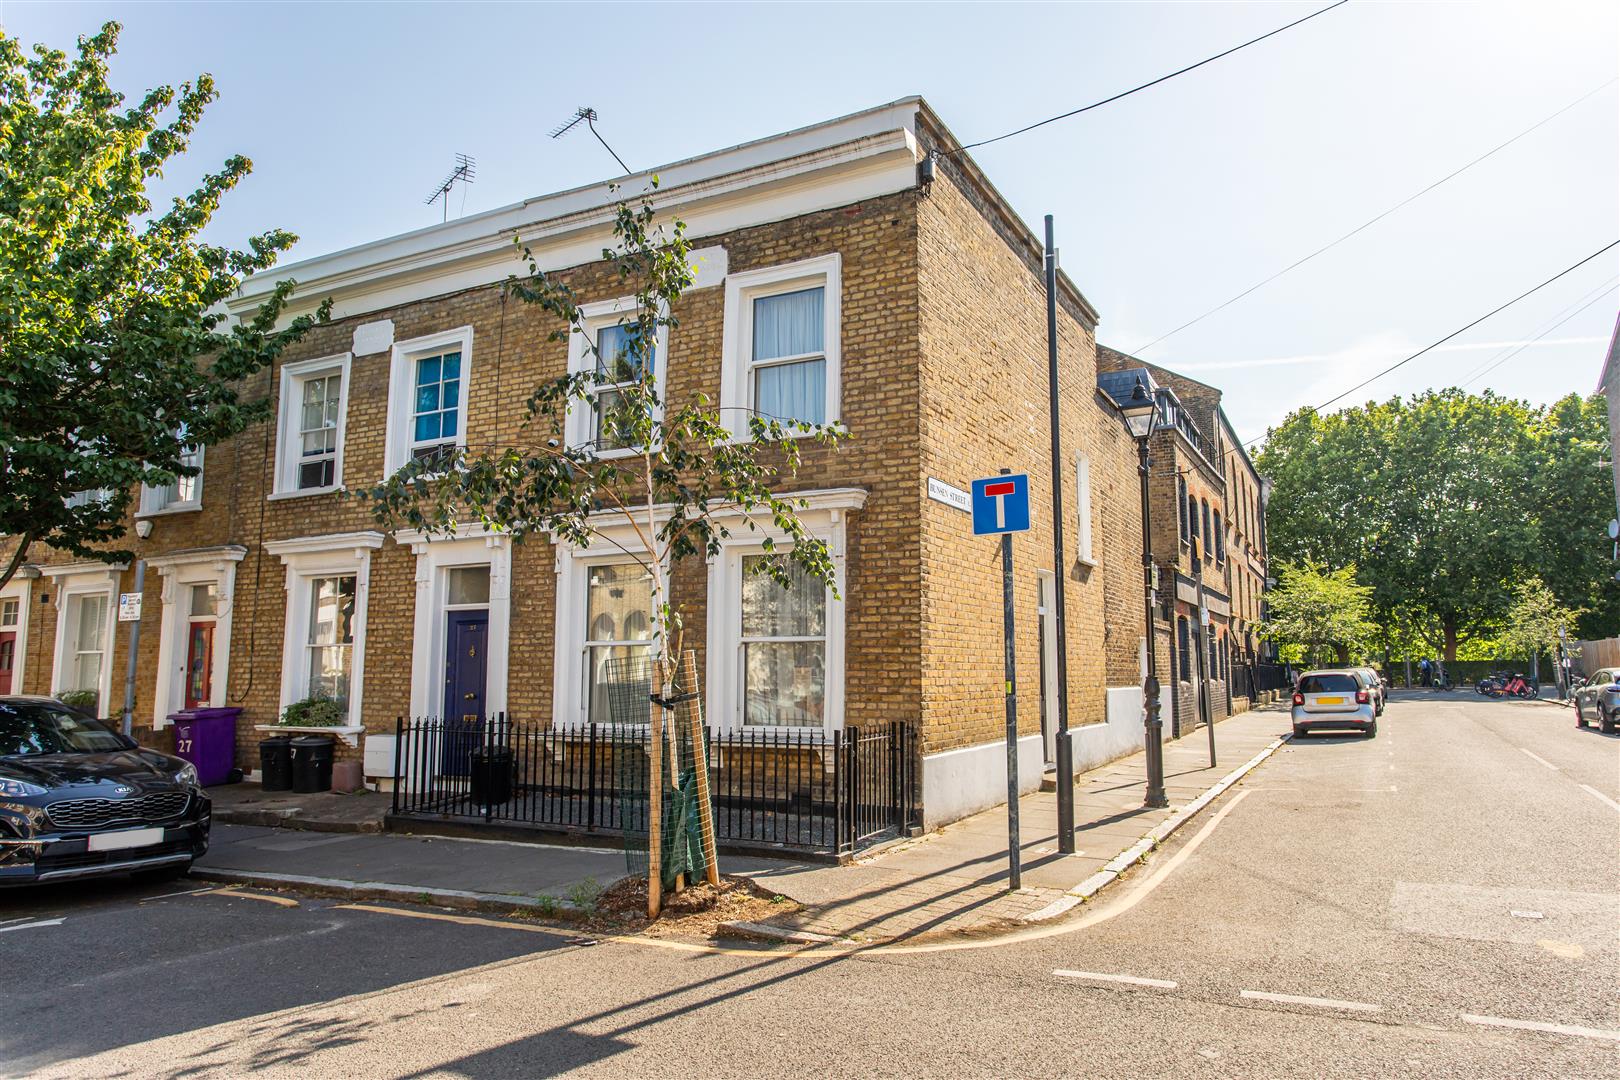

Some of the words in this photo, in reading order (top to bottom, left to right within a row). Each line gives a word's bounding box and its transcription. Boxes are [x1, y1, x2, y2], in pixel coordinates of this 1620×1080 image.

[929, 483, 948, 498] BUNSEN
[949, 492, 966, 505] STREET
[178, 740, 193, 753] 27
